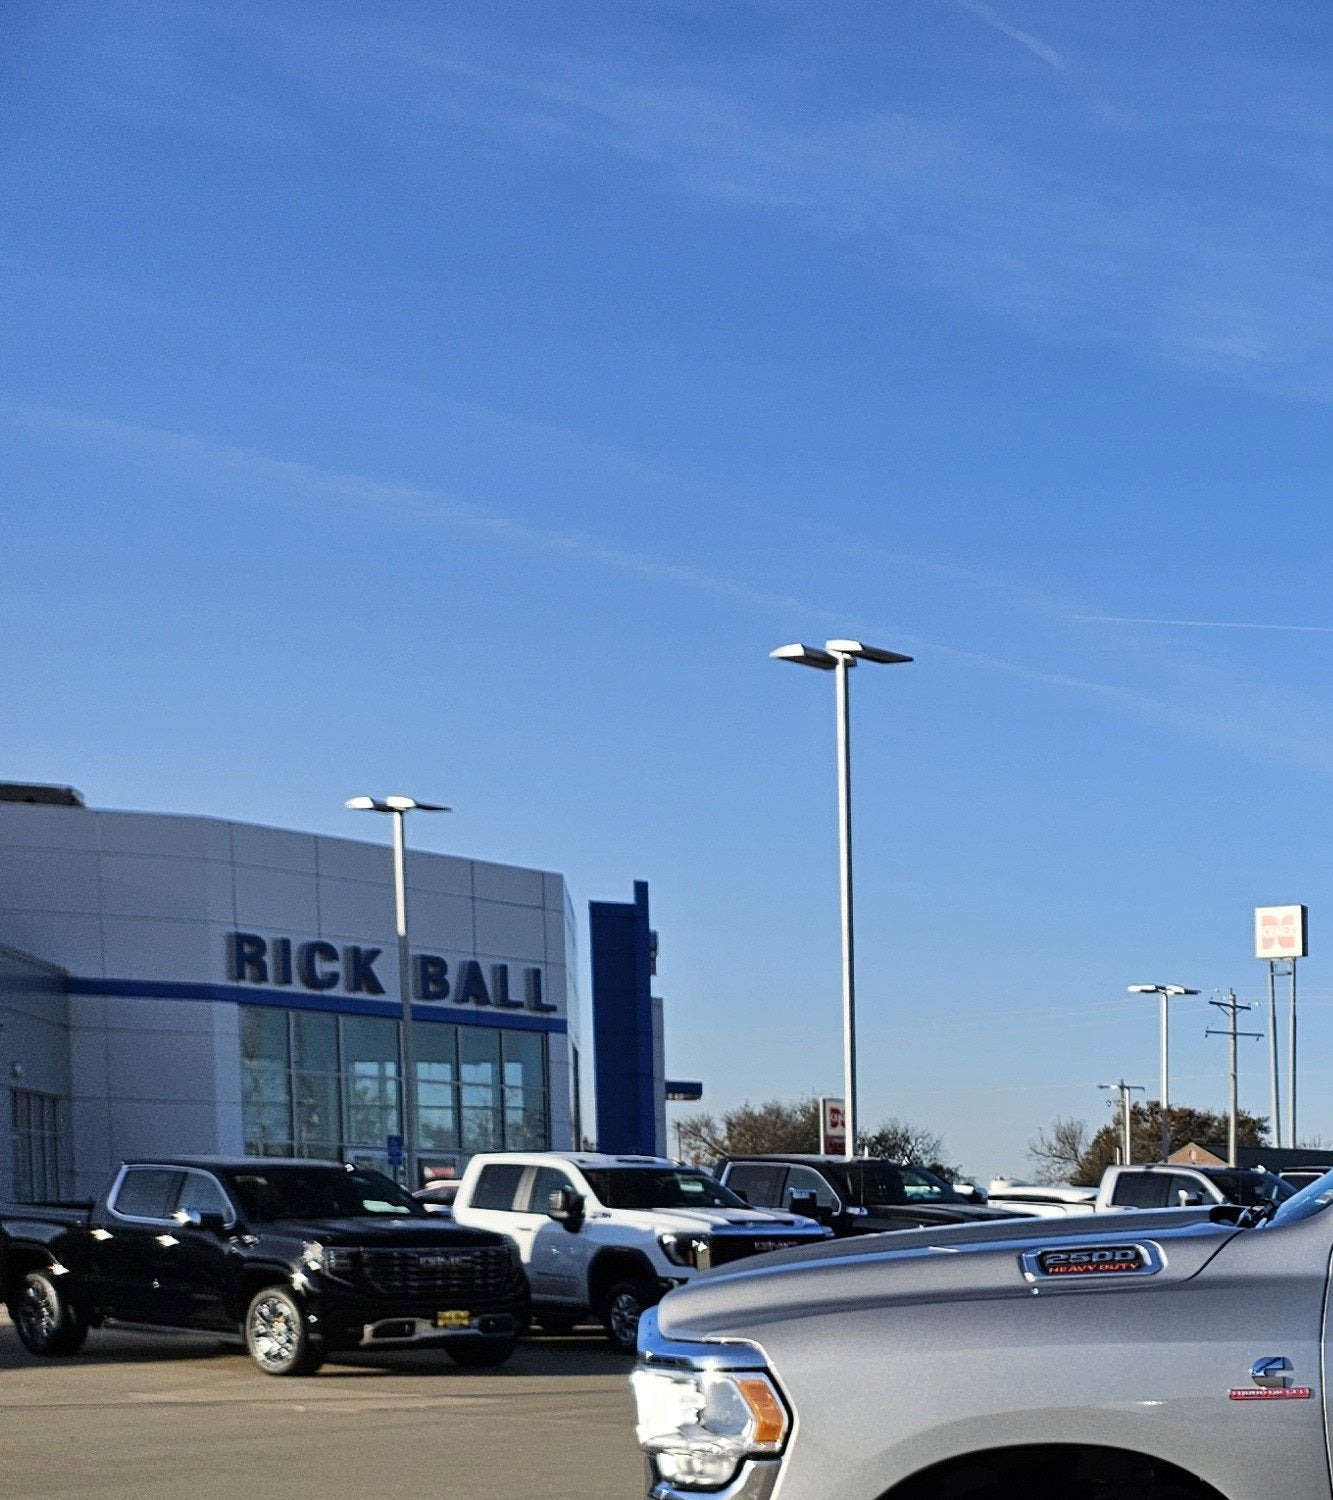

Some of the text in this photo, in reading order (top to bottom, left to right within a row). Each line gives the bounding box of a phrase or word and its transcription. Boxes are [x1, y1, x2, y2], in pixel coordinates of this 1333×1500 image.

[225, 931, 557, 1013] RICK BALL
[1045, 1249, 1136, 1264] 2500
